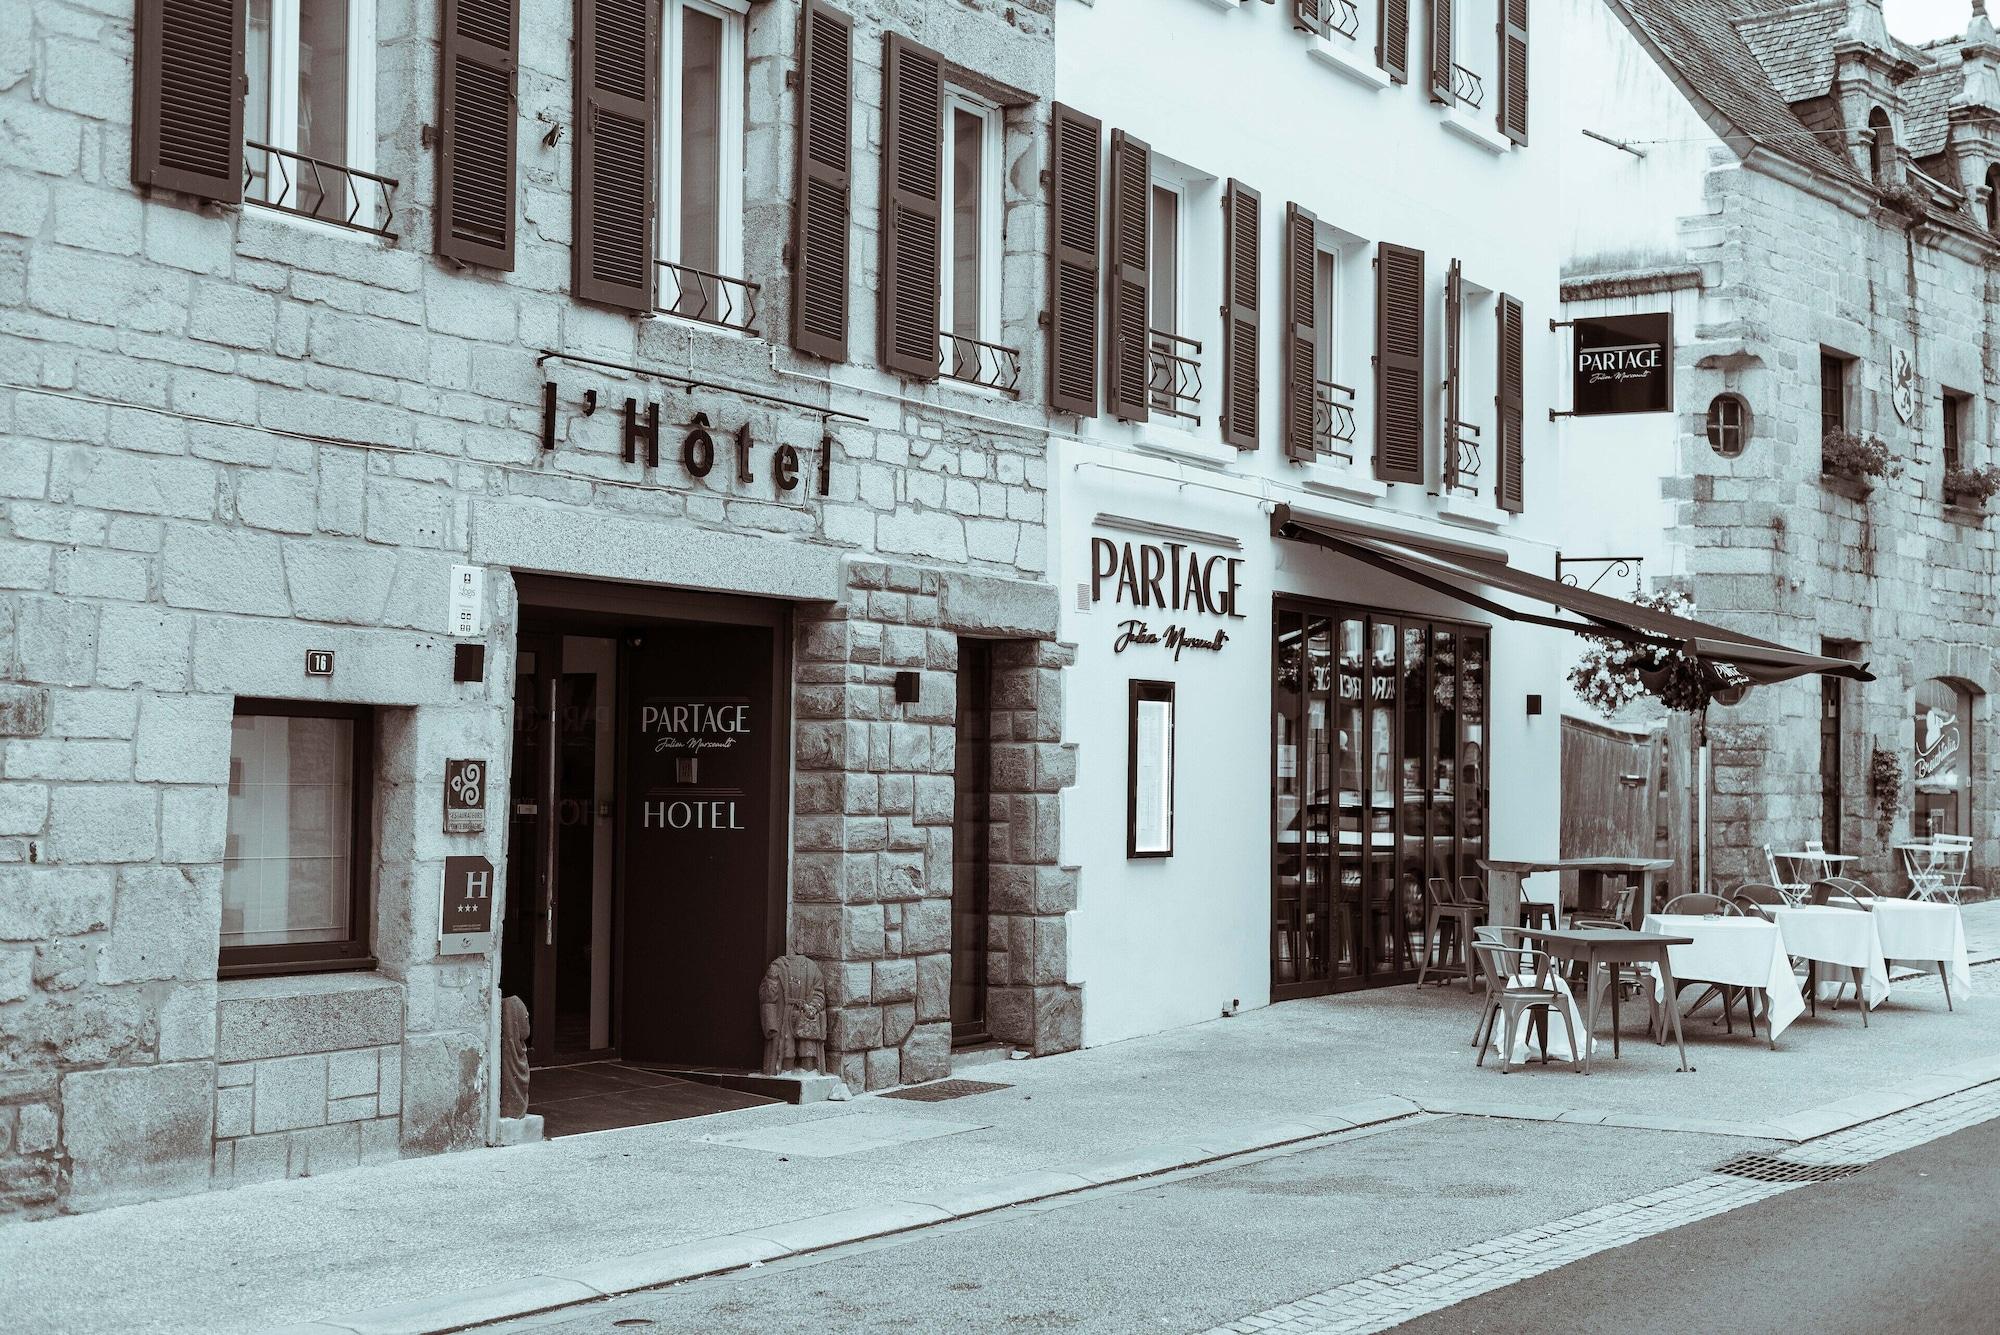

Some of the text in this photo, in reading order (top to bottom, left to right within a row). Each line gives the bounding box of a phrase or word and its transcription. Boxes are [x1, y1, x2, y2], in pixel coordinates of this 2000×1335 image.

[1579, 349, 1662, 372] PARTAGE
[1091, 537, 1247, 618] PARTAGE
[315, 655, 327, 671] 16
[642, 703, 751, 733] PARTAGE
[644, 801, 745, 829] HOTEL
[464, 871, 490, 899] H
